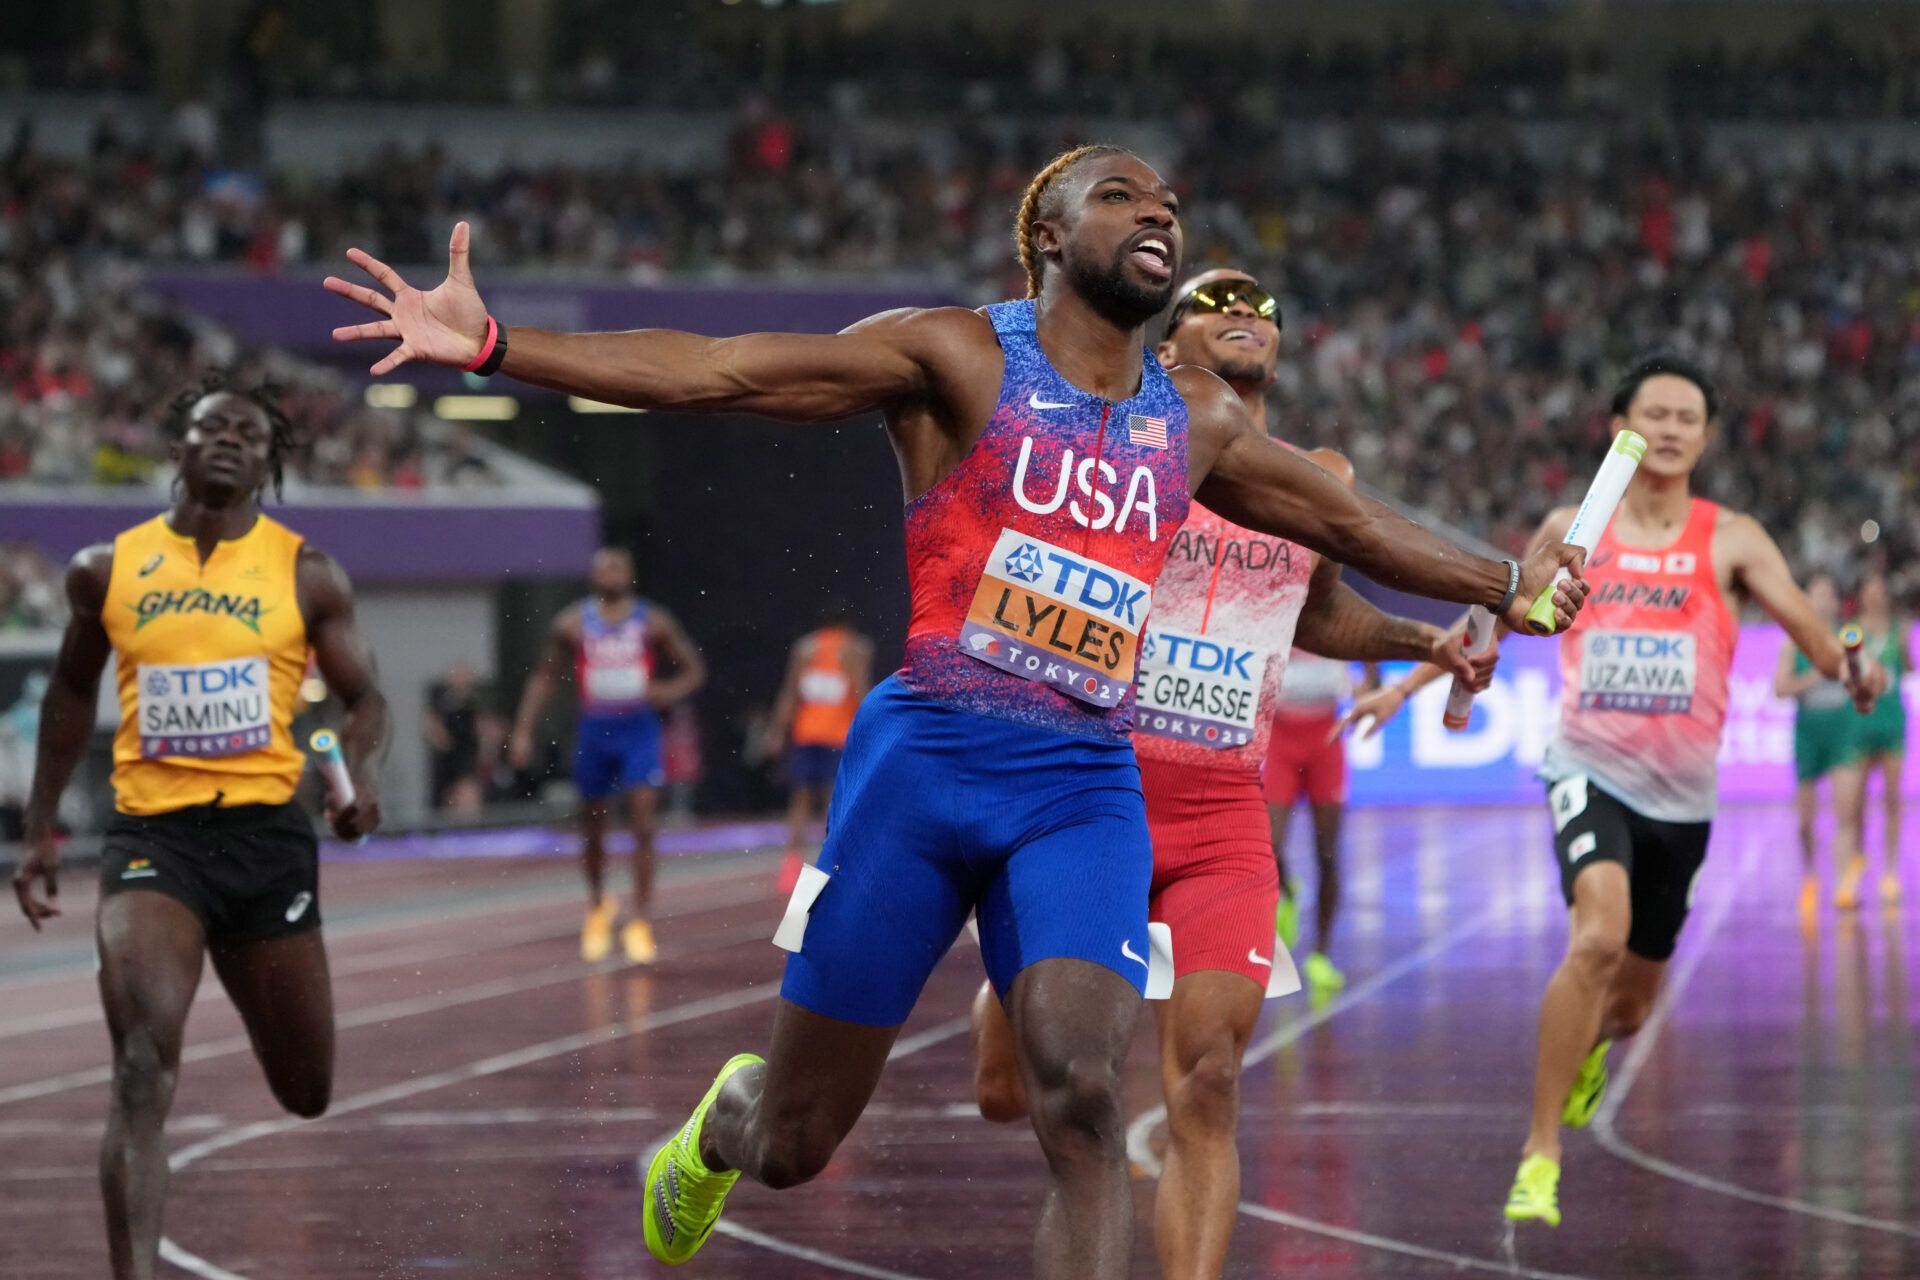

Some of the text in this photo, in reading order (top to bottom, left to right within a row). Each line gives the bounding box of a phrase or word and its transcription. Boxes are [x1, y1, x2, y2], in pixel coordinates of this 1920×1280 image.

[1013, 436, 1157, 542] USA
[1167, 529, 1291, 574] ANADA
[138, 589, 260, 617] GHANA
[1048, 552, 1147, 627] TDK
[1589, 580, 1690, 608] JAPAN
[993, 587, 1125, 671] LYLES
[1613, 636, 1683, 659] TDK
[1159, 633, 1256, 681] TDK
[1588, 663, 1688, 690] UZAWA
[170, 662, 256, 696] TDK
[1154, 674, 1253, 722] GRASSE
[146, 694, 263, 732] SAMINU
